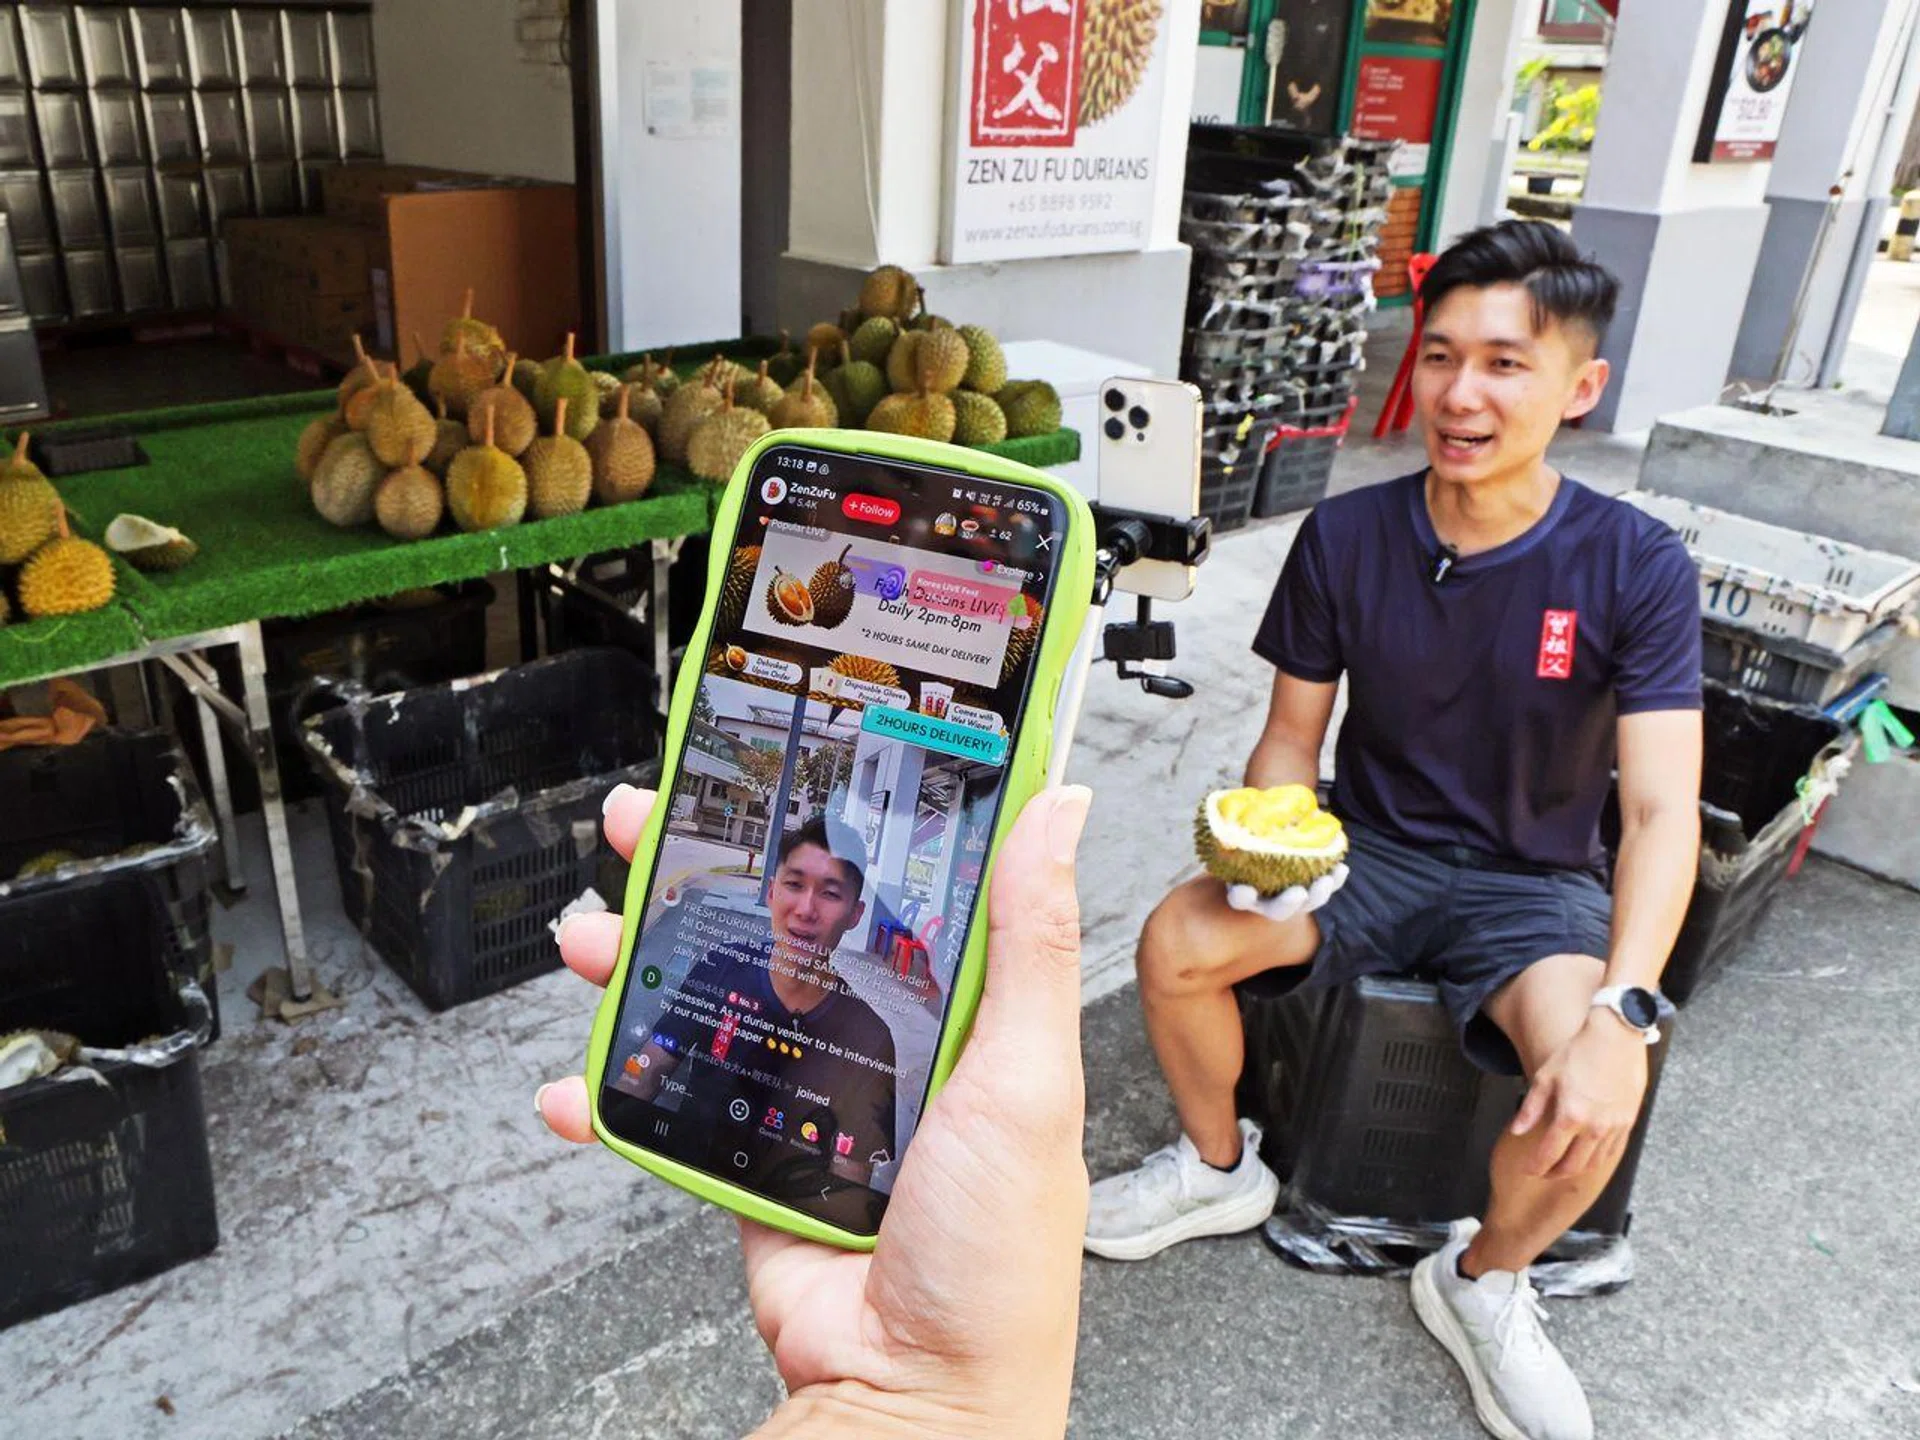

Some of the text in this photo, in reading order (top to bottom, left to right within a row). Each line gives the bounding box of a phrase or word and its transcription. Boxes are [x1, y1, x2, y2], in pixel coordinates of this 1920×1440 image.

[967, 157, 1149, 184] ZEN ZU FU DURIANS
[777, 456, 804, 470] 13:18
[1016, 499, 1040, 514] 65%
[790, 482, 837, 500] ZenZuFu
[796, 498, 818, 510] 5.4K
[806, 526, 828, 538] LIVE
[999, 530, 1013, 541] 62
[996, 564, 1035, 580] Explore
[1706, 579, 1752, 618] 10
[878, 598, 982, 634] Daily 2pm-8pm
[872, 631, 904, 646] HOURS
[905, 638, 931, 652] SAME
[931, 644, 952, 656] DAY
[951, 648, 993, 666] DELIVERY
[953, 705, 994, 722] Comes with
[930, 727, 993, 753] DELIVERY!
[680, 915, 694, 928] All
[695, 920, 729, 940] Orders
[730, 933, 748, 946] will
[749, 939, 761, 951] be
[684, 901, 718, 920] FRESH
[718, 912, 765, 936] DURIANS
[818, 946, 842, 961] LIVE
[874, 962, 896, 979] you
[897, 972, 930, 990] order!
[677, 930, 708, 948] durian
[709, 942, 751, 963] cravings
[797, 972, 821, 986] with
[822, 979, 838, 991] us!
[739, 997, 750, 1008] No.
[660, 998, 764, 1045] by our national paper
[663, 985, 718, 1013] Impressive.
[719, 1005, 734, 1018] As
[743, 1014, 776, 1033] durian
[776, 1026, 813, 1046] vendor
[815, 1038, 827, 1051] to
[828, 1042, 843, 1057] be
[844, 1047, 908, 1080] interviewed
[795, 1085, 830, 1107] joined
